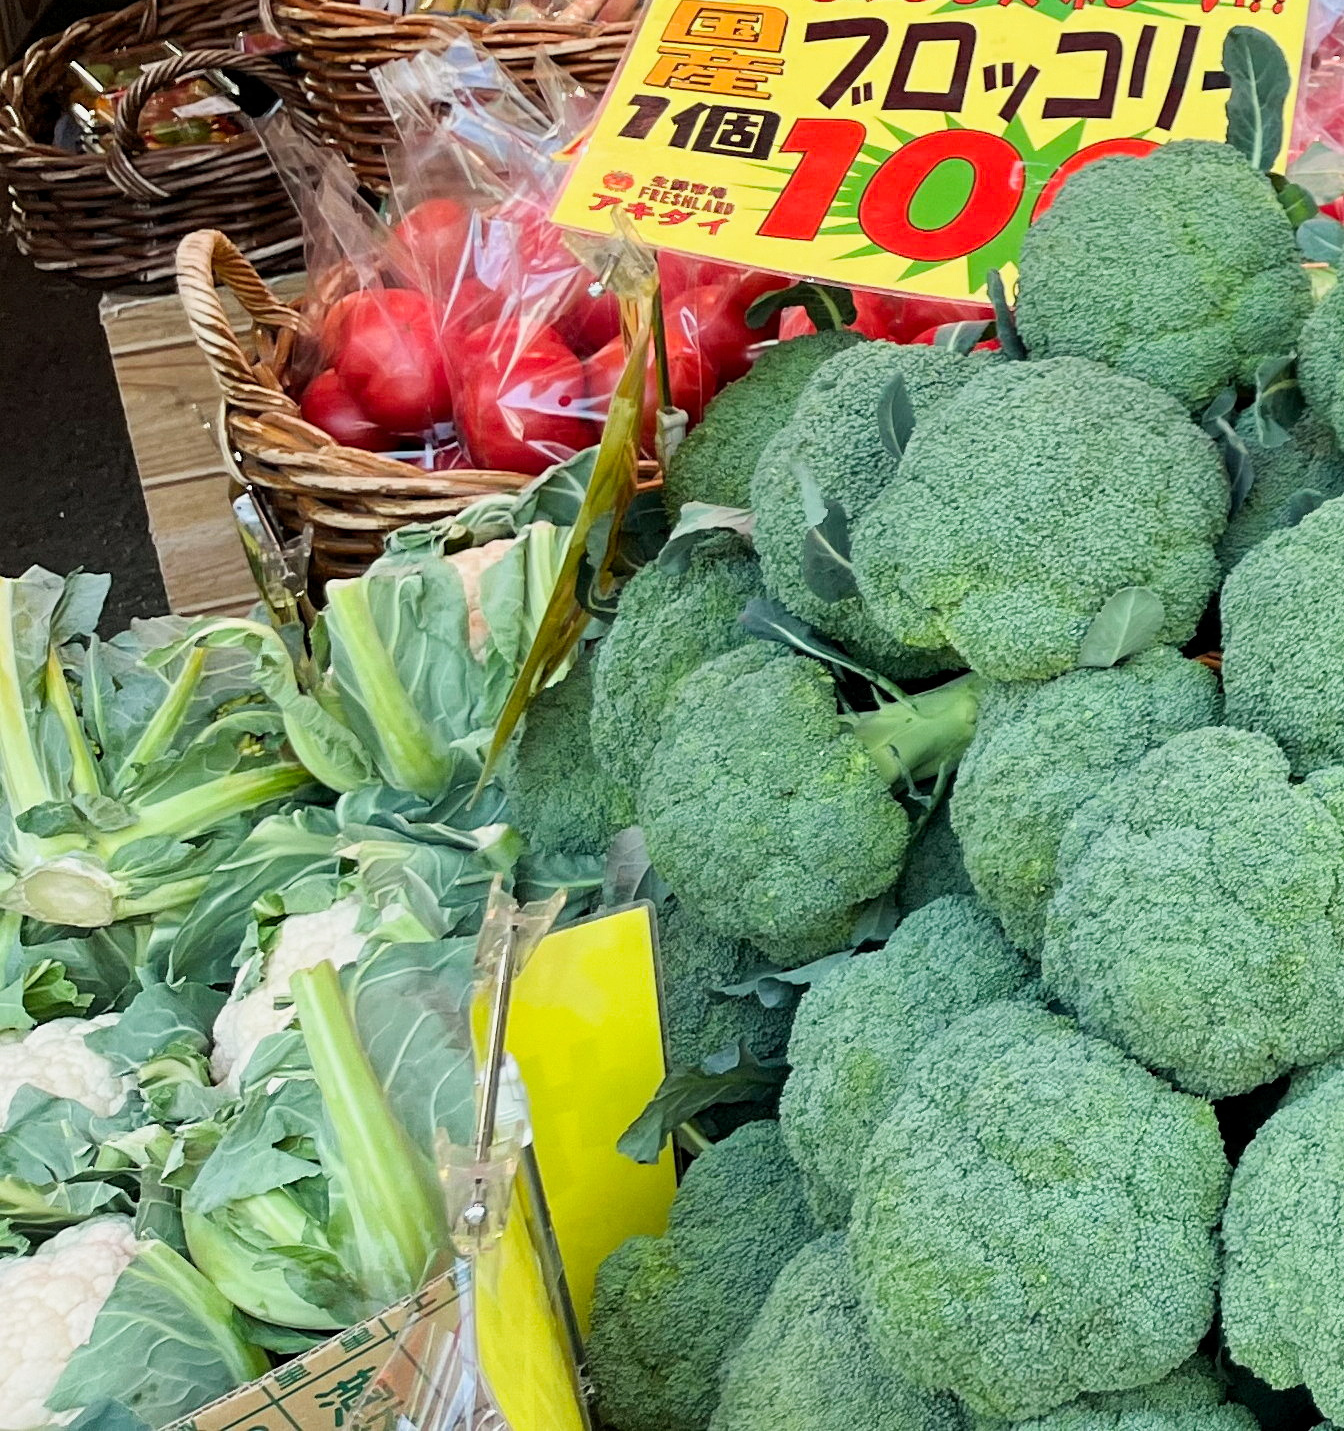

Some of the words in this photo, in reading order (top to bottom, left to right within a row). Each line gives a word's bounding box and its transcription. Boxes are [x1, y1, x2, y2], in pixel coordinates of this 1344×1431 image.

[616, 93, 783, 162] 1個
[754, 116, 1164, 262] 10
[649, 174, 729, 201] 生鮮市場
[588, 191, 730, 237] アキダイ
[636, 185, 736, 217] FRESHLAND
